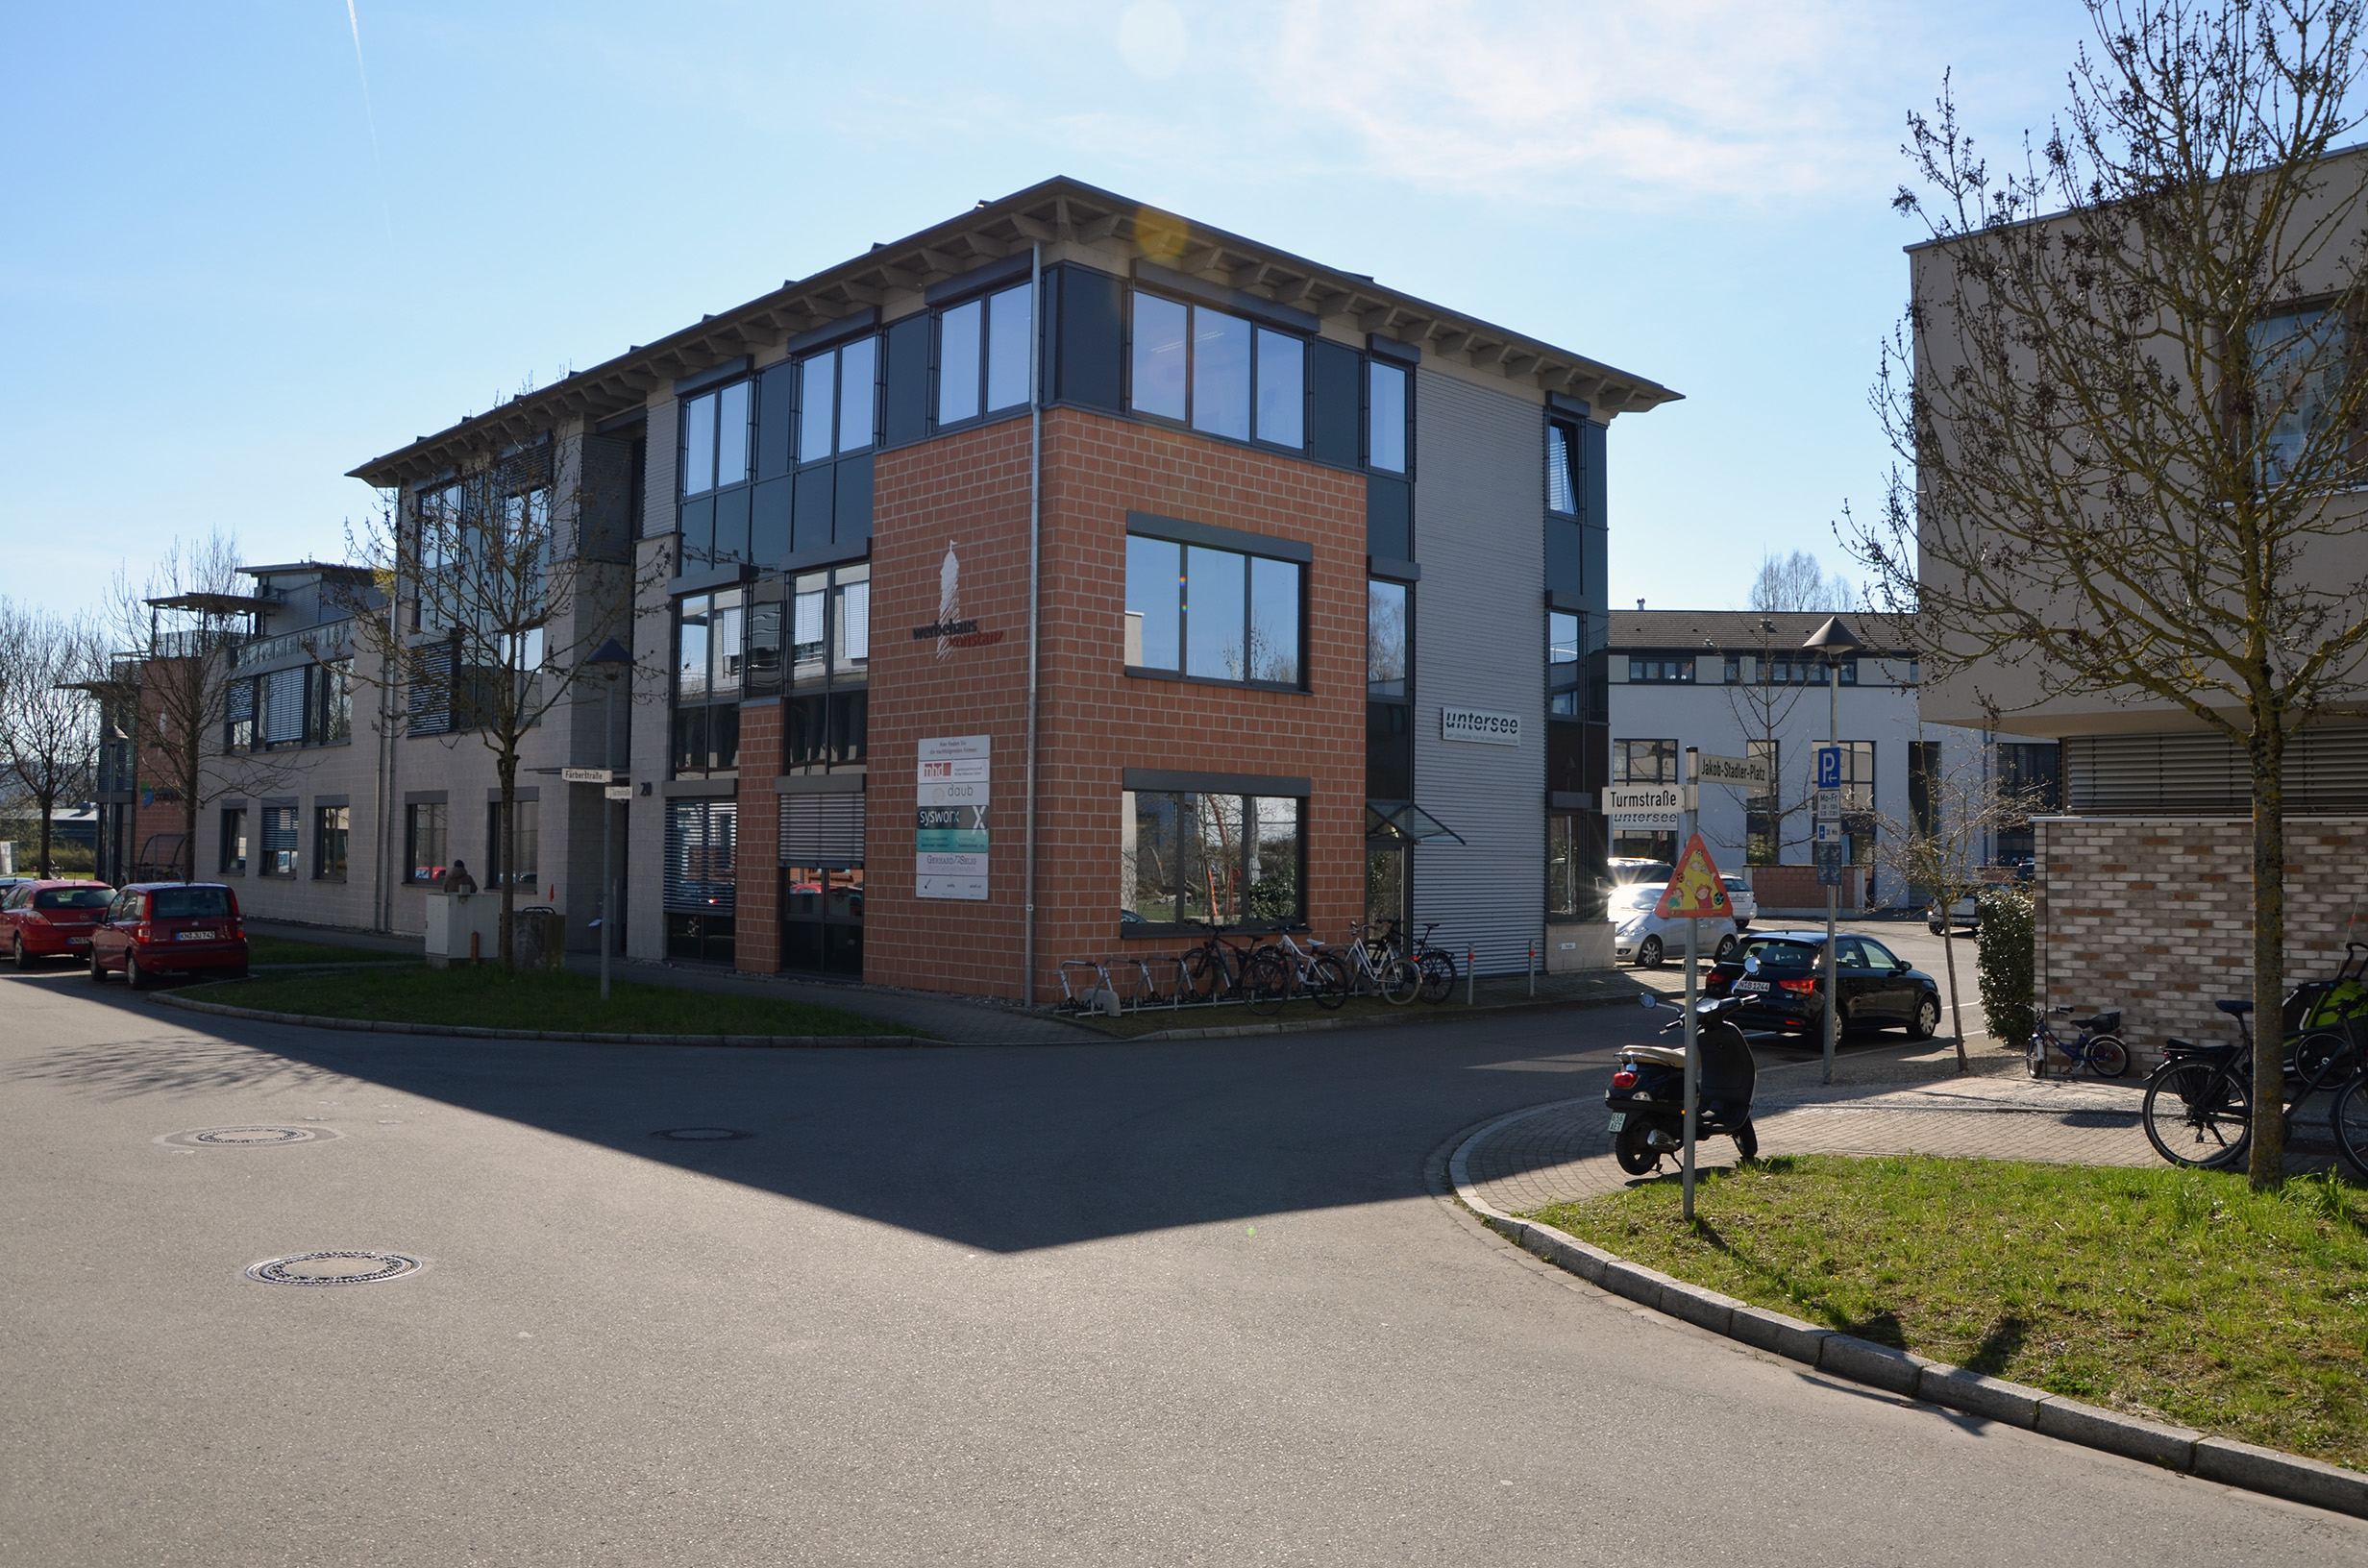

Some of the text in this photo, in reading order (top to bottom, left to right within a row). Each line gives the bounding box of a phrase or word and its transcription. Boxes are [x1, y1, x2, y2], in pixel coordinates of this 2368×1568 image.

[912, 618, 977, 641] werbehaus
[1445, 712, 1518, 734] untersee
[565, 770, 603, 780] Färberstraße
[1701, 759, 1765, 782] Jakob-Stadler-Platz
[1822, 752, 1836, 784] P
[640, 781, 653, 796] 20
[948, 783, 974, 796] daub
[1610, 790, 1677, 808] Turmstraße
[1819, 793, 1838, 802] Mo-Fr
[920, 810, 959, 826] sysworx
[1614, 813, 1678, 822] untersee
